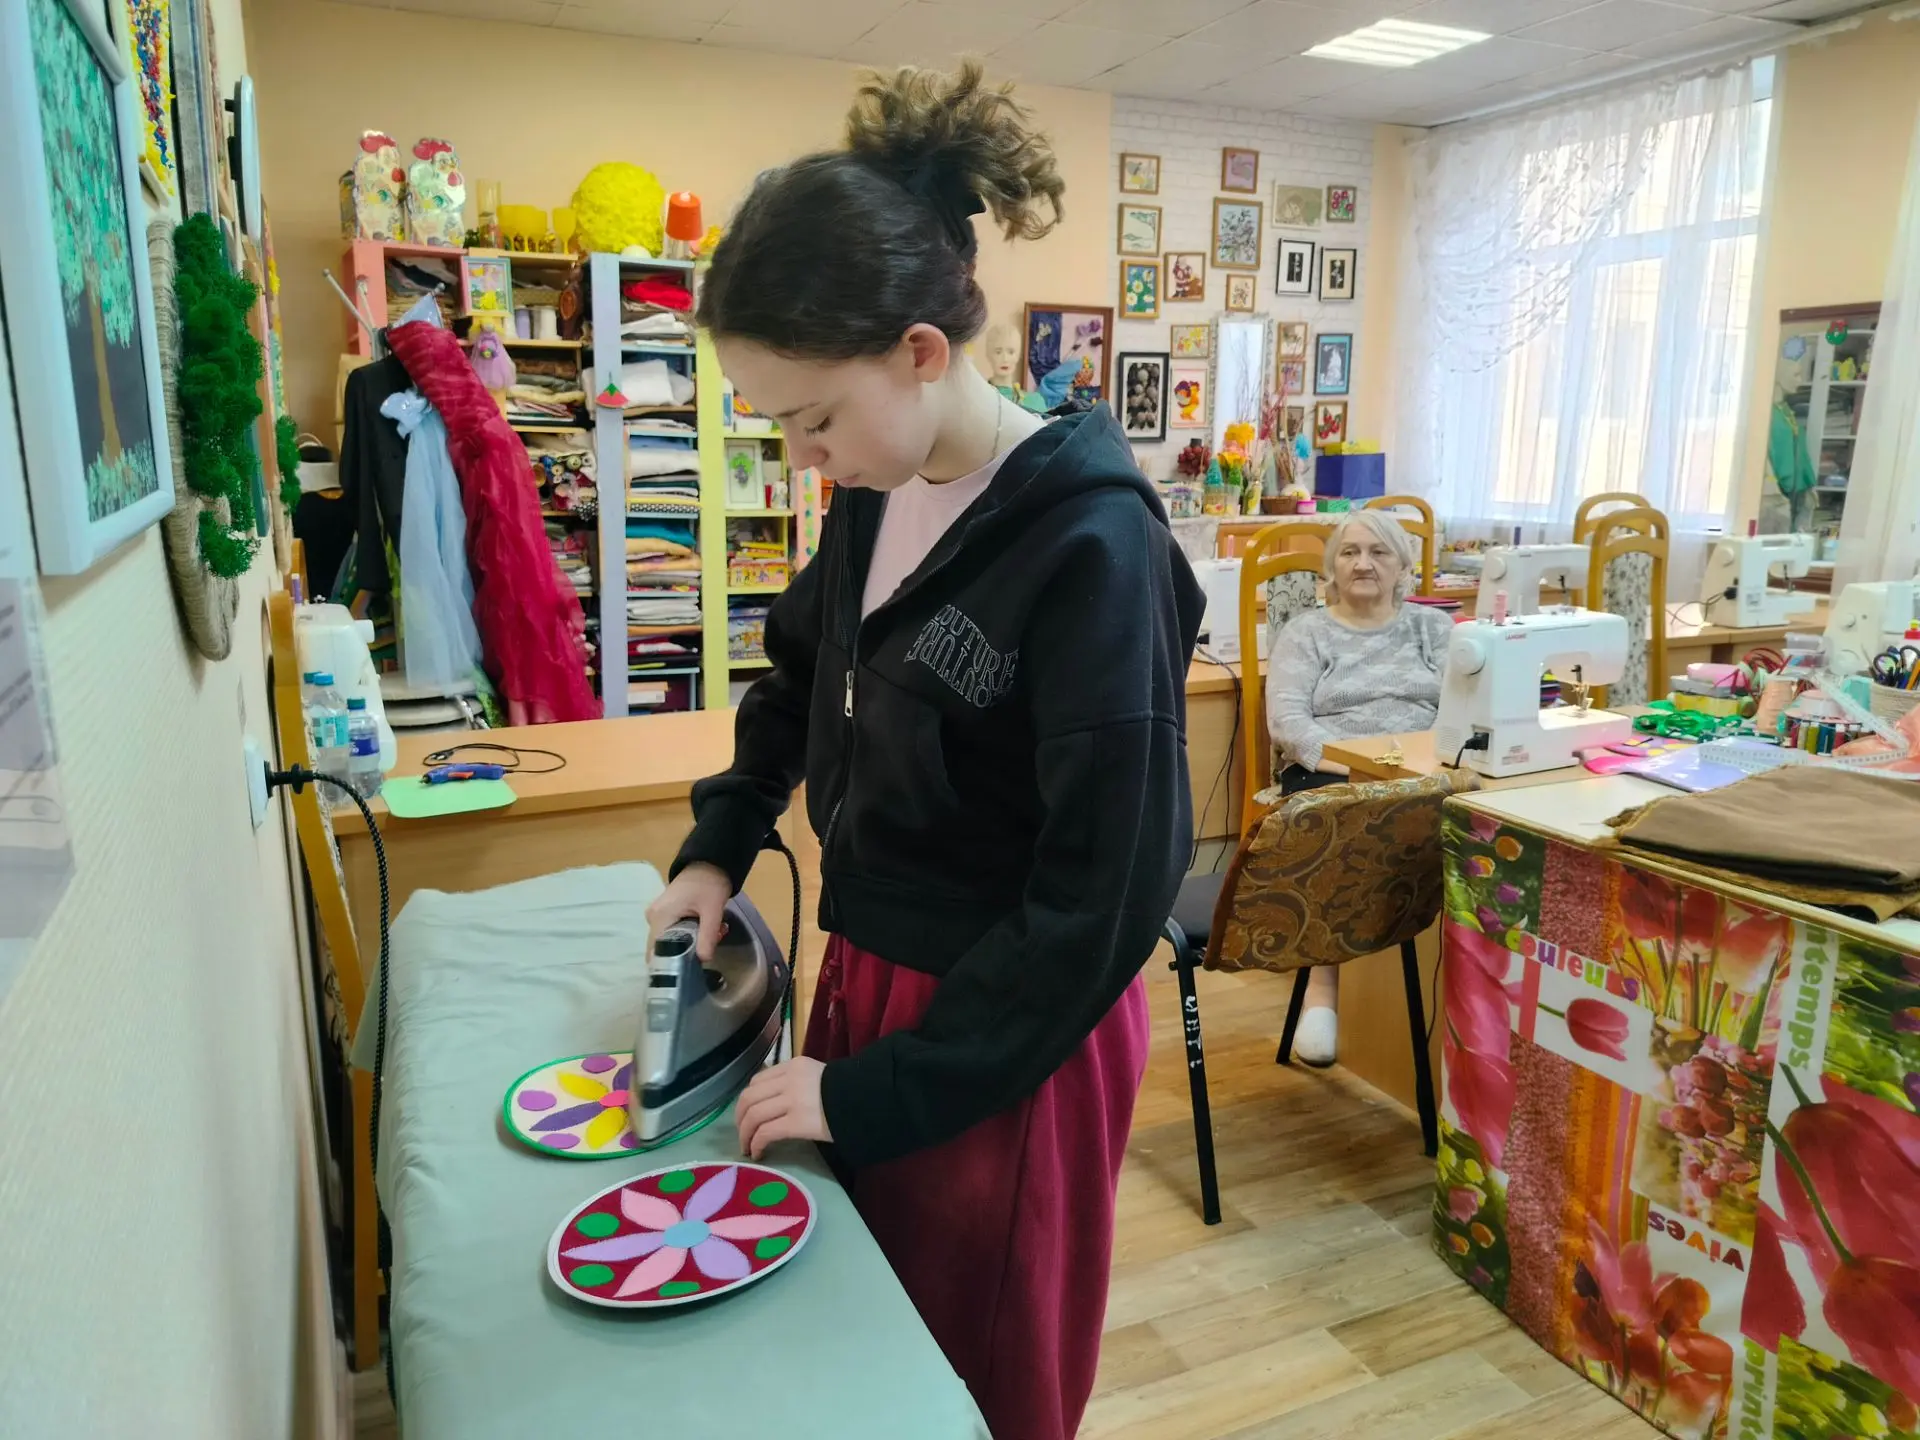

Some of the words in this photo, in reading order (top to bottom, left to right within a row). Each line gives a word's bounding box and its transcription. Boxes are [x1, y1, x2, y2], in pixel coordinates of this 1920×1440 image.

[903, 619, 995, 708] OUTURE
[1505, 928, 1641, 1001] couleurs
[1648, 1210, 1745, 1272] vives
